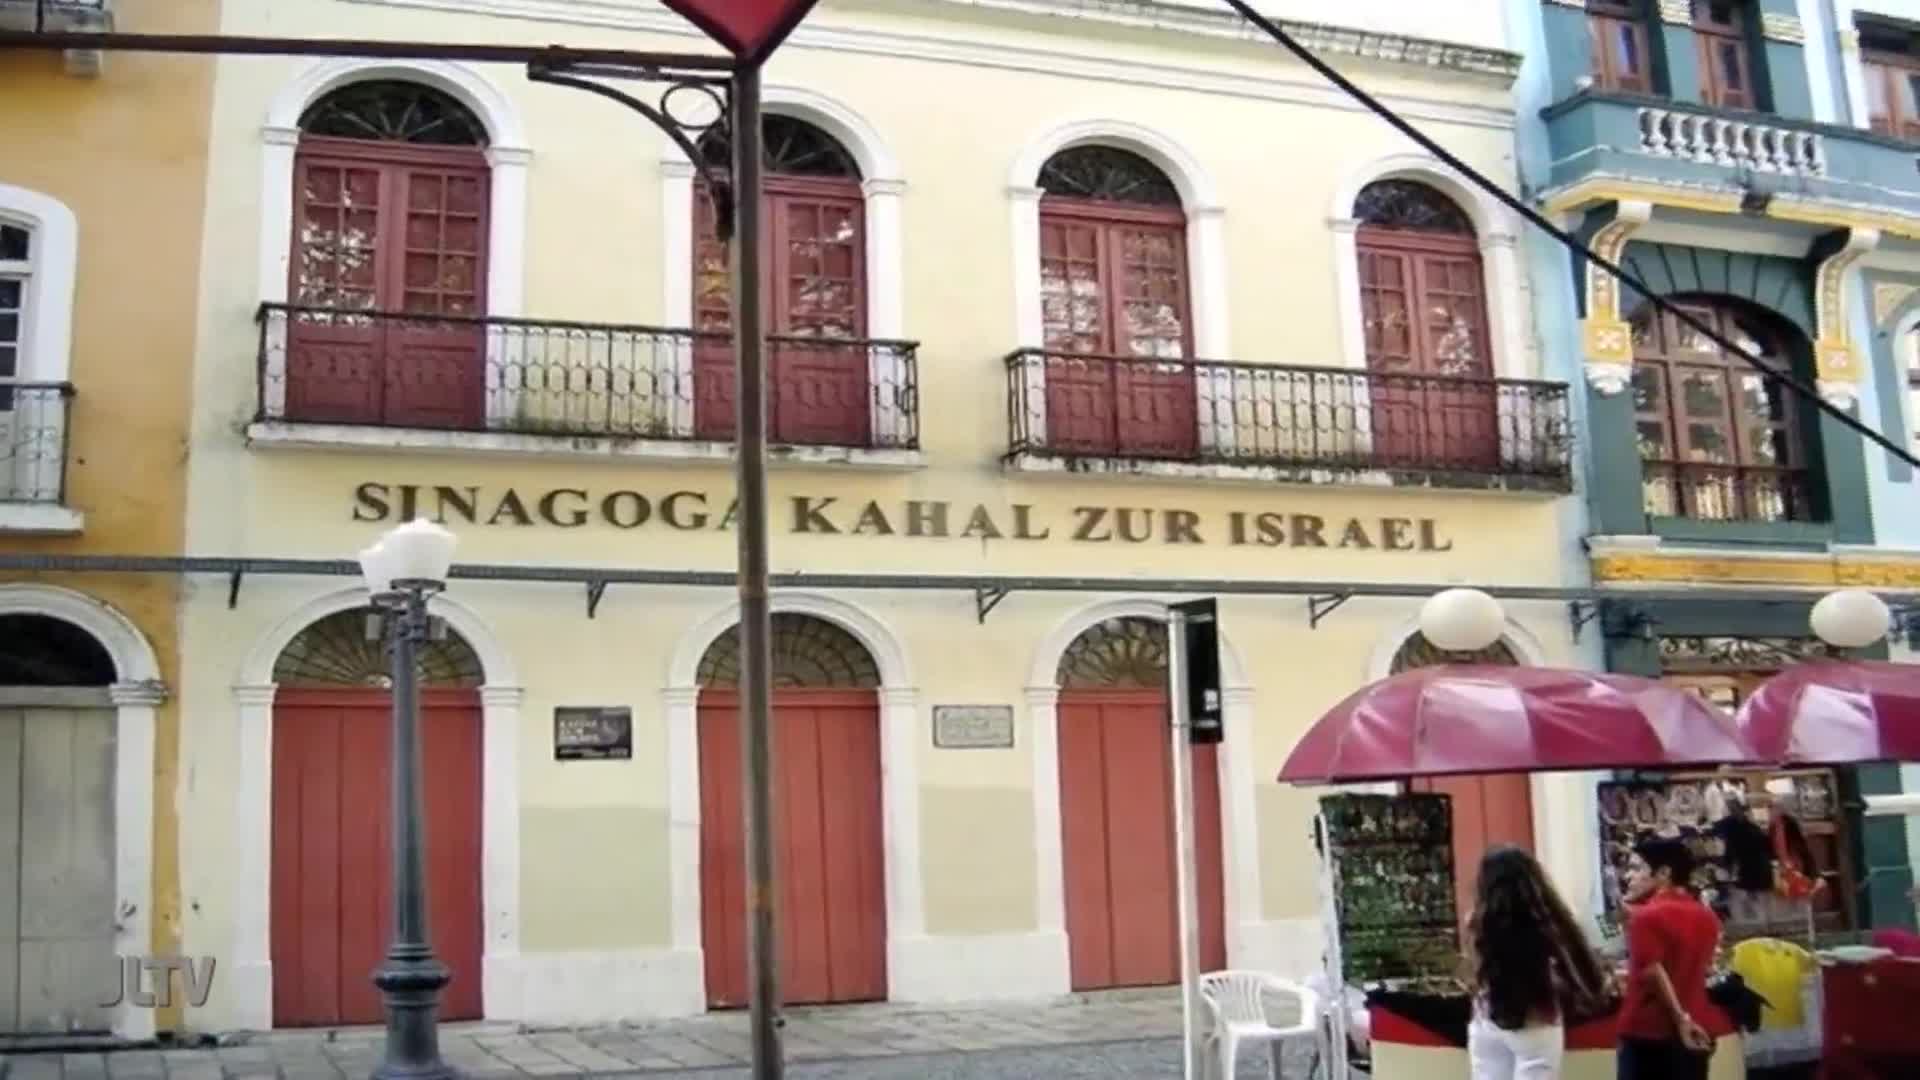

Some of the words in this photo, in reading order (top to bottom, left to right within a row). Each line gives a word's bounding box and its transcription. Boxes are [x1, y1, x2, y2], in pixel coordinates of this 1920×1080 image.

[790, 495, 1050, 541] KAHAL
[1073, 505, 1204, 545] ZUR
[1227, 511, 1452, 553] ISRAEL
